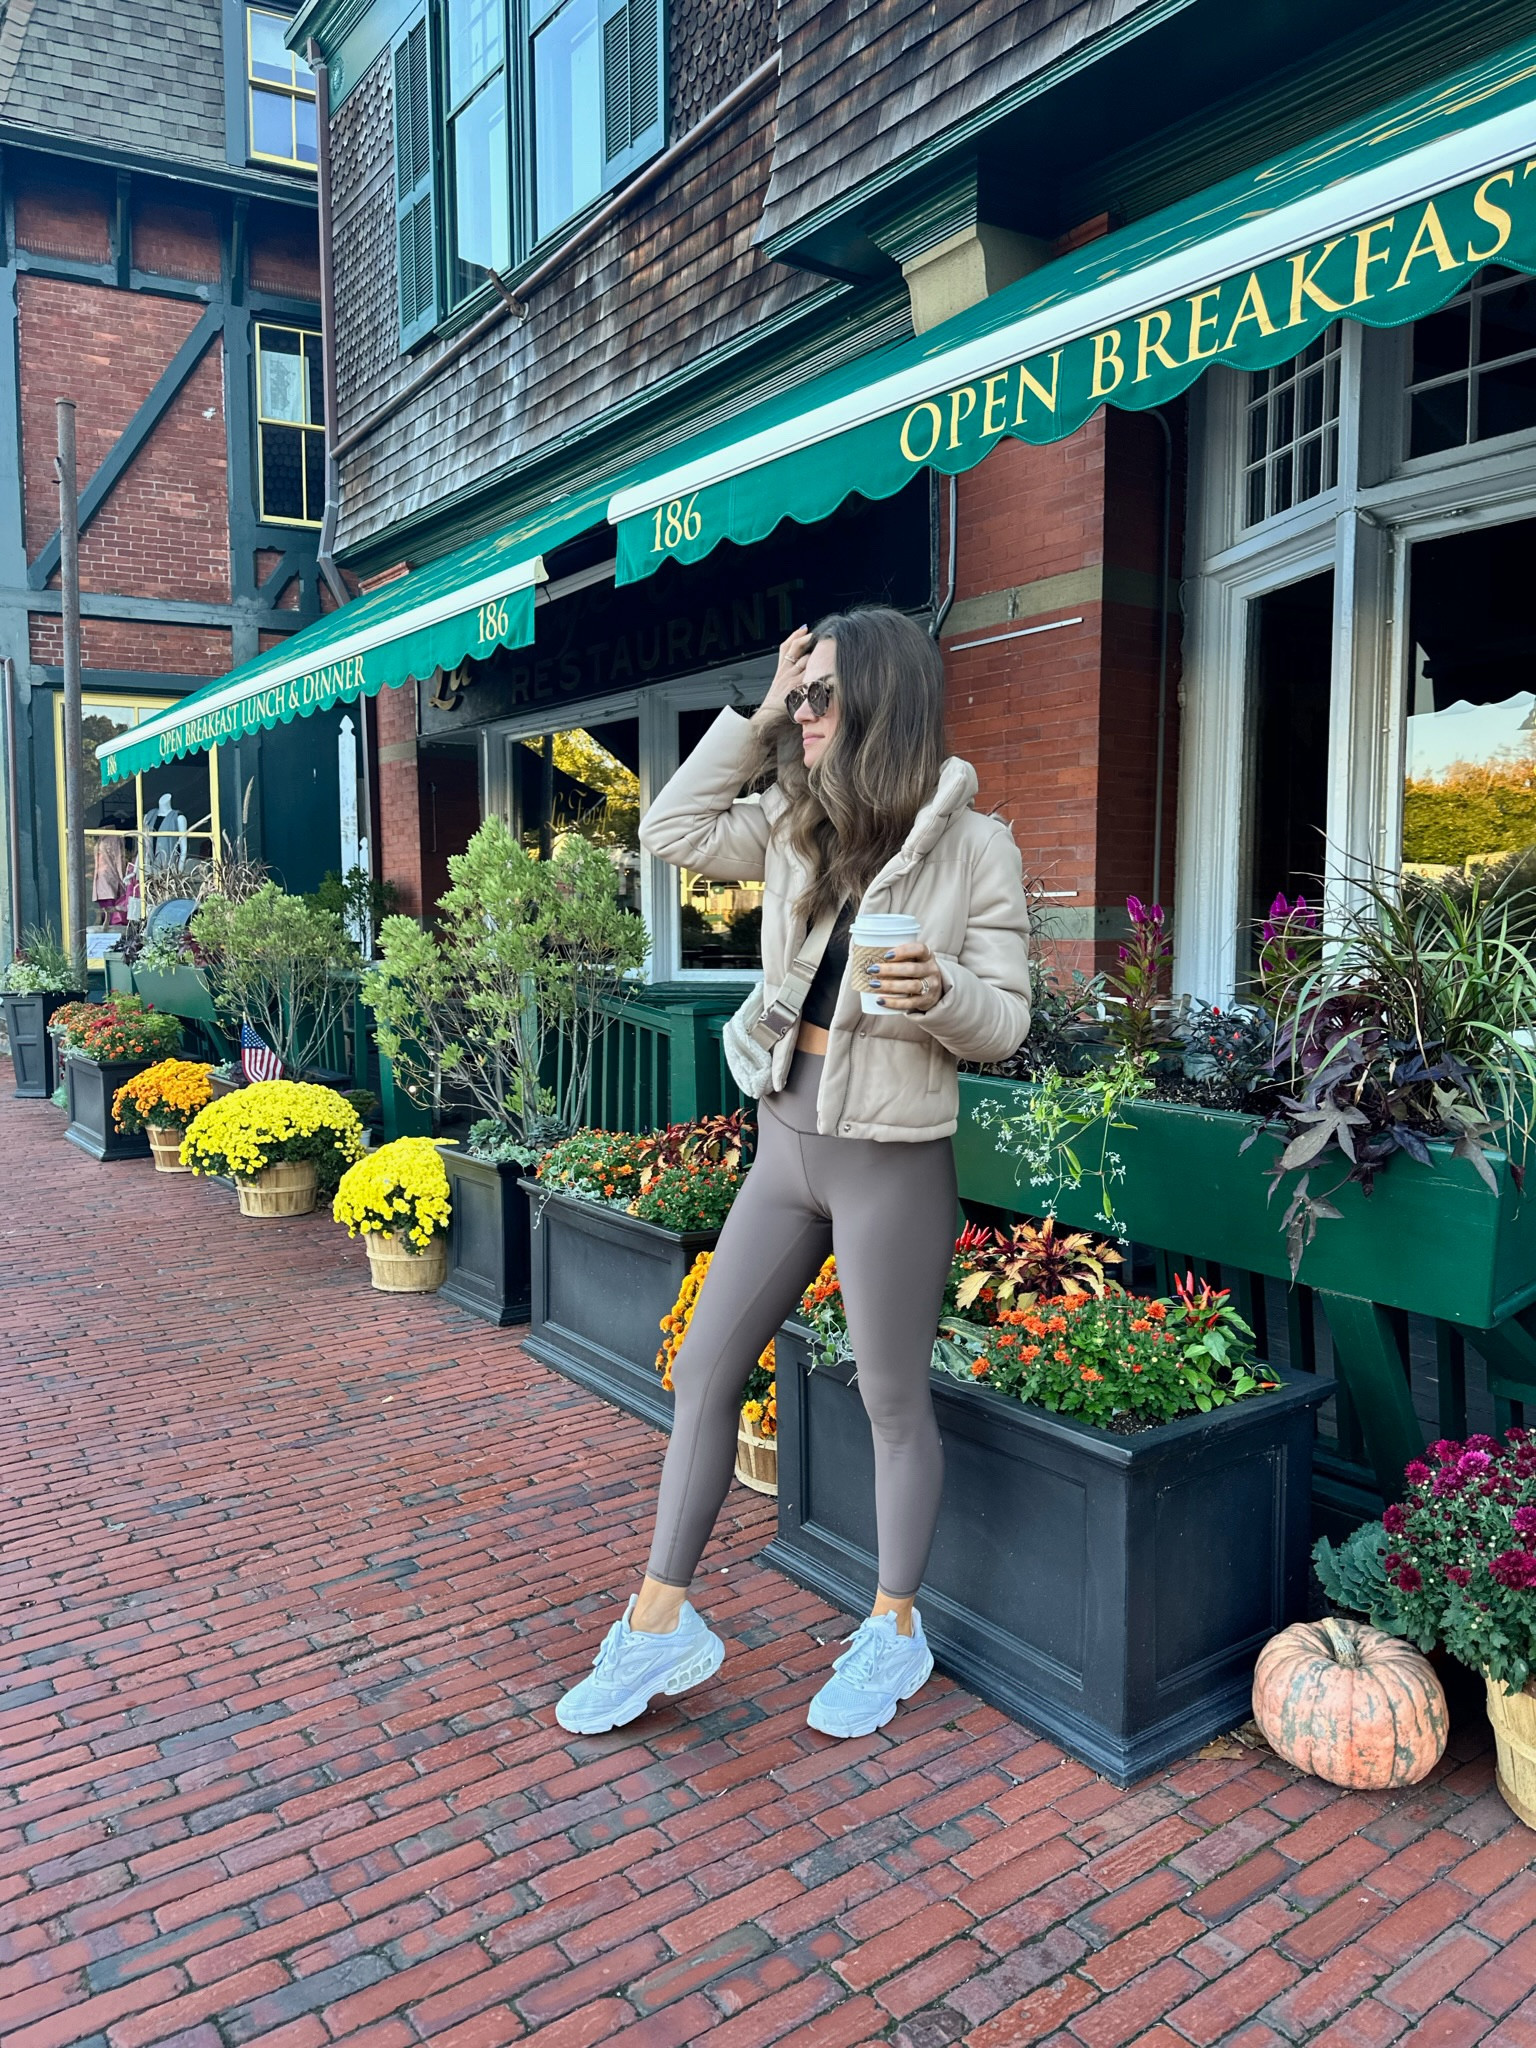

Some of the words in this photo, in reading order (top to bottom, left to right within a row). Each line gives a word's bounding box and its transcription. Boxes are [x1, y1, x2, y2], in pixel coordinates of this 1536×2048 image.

[899, 350, 1064, 463] OPEN
[650, 492, 702, 553] 186
[476, 598, 509, 644] 186
[511, 577, 806, 705] RESTAURANT
[159, 724, 183, 757] OPEN
[184, 703, 240, 747] BREAKFAST
[241, 684, 286, 727] LUNCH
[288, 680, 301, 709] &
[303, 655, 366, 705] DINNER
[106, 754, 118, 777] 186
